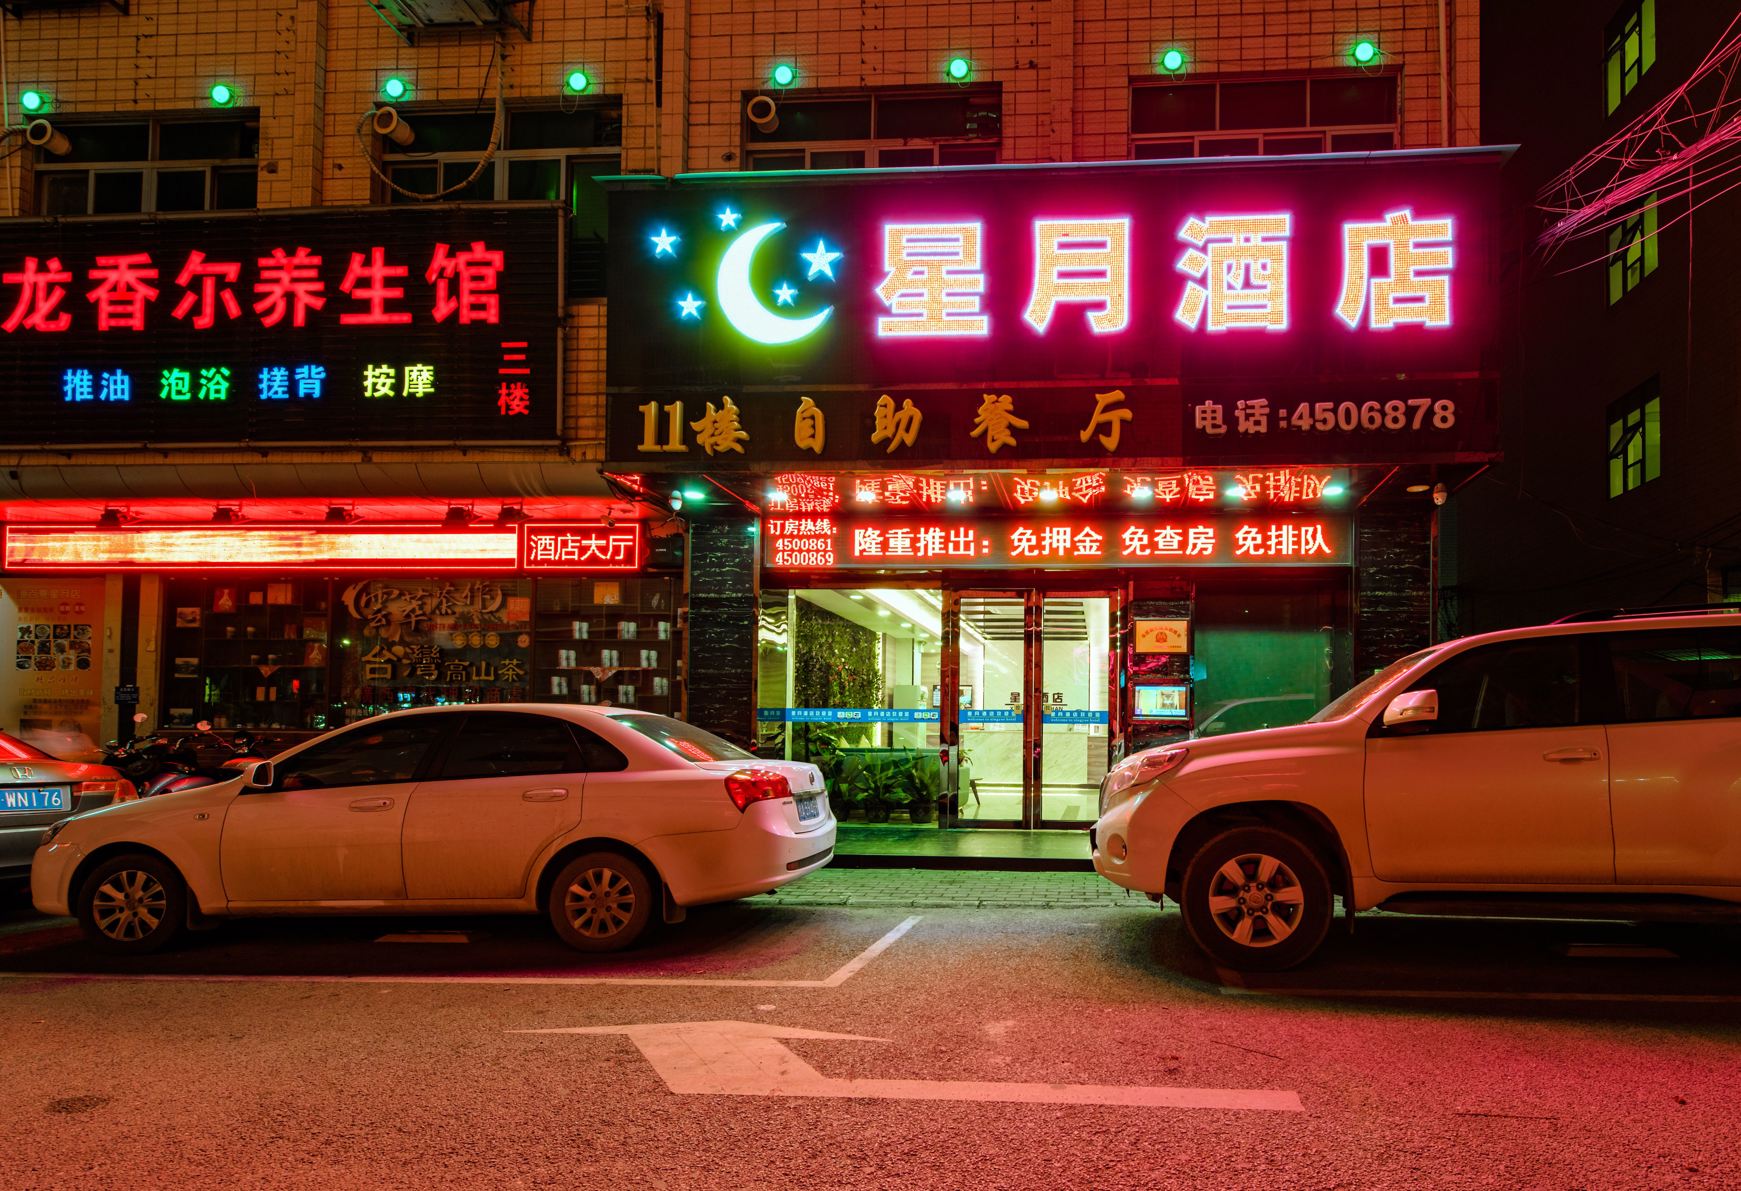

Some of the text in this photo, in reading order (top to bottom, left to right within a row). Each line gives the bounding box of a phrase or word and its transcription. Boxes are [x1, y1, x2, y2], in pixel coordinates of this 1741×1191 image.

[1, 240, 505, 333] 龙香尔养生馆
[875, 208, 1457, 338] 星月酒店
[63, 363, 436, 402] 推油 泡浴 搓背 按摩
[497, 341, 531, 416] 三楼
[637, 390, 1133, 456] 11楼自助餐厅
[768, 519, 837, 535] 订房热线：
[775, 538, 833, 551] 4500861
[1010, 526, 1103, 557] 免押金
[1121, 525, 1216, 555] 免查房
[1234, 524, 1332, 555] 免排队
[529, 533, 634, 561] 酒店大厅
[775, 552, 834, 566] 4500869
[361, 644, 526, 683] 台灣高山茶
